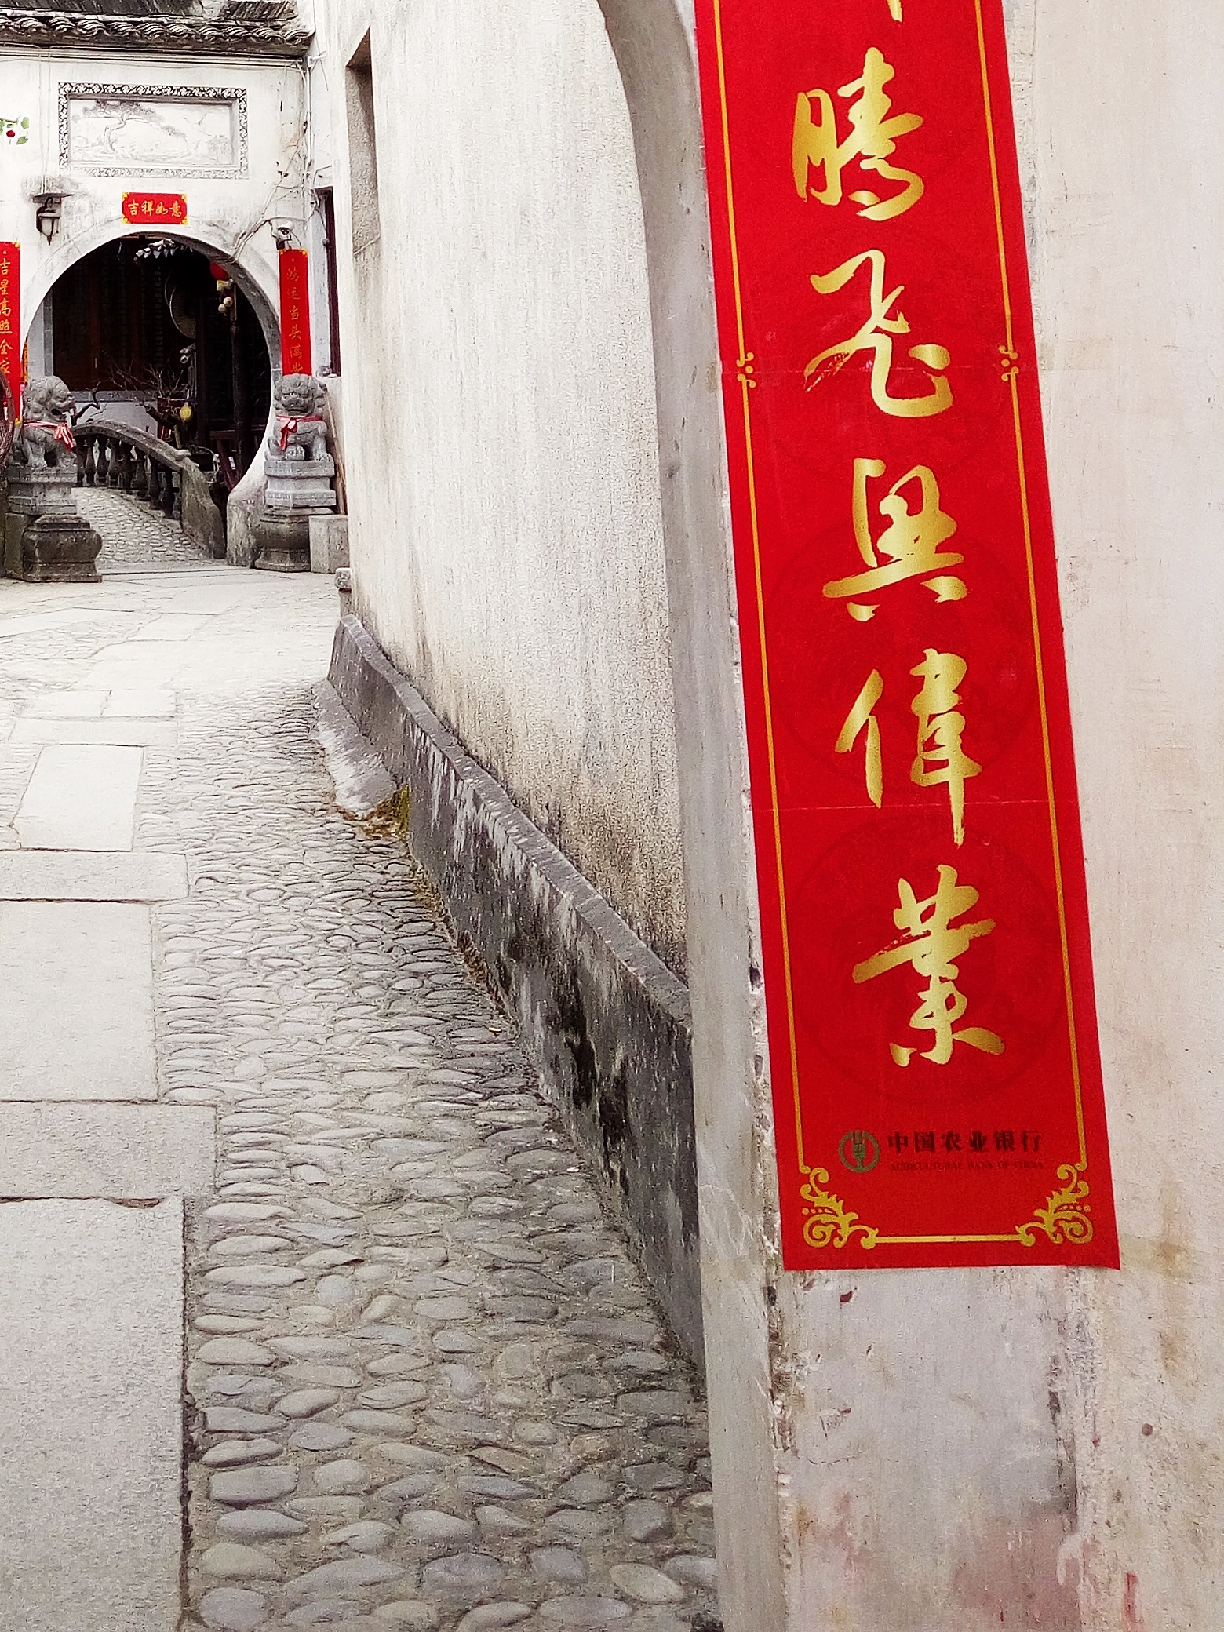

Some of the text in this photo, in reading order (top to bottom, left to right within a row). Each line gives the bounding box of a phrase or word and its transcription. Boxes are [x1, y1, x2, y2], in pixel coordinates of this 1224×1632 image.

[128, 199, 182, 217] 吉祥如意
[887, 1130, 1041, 1153] 中国农业银行
